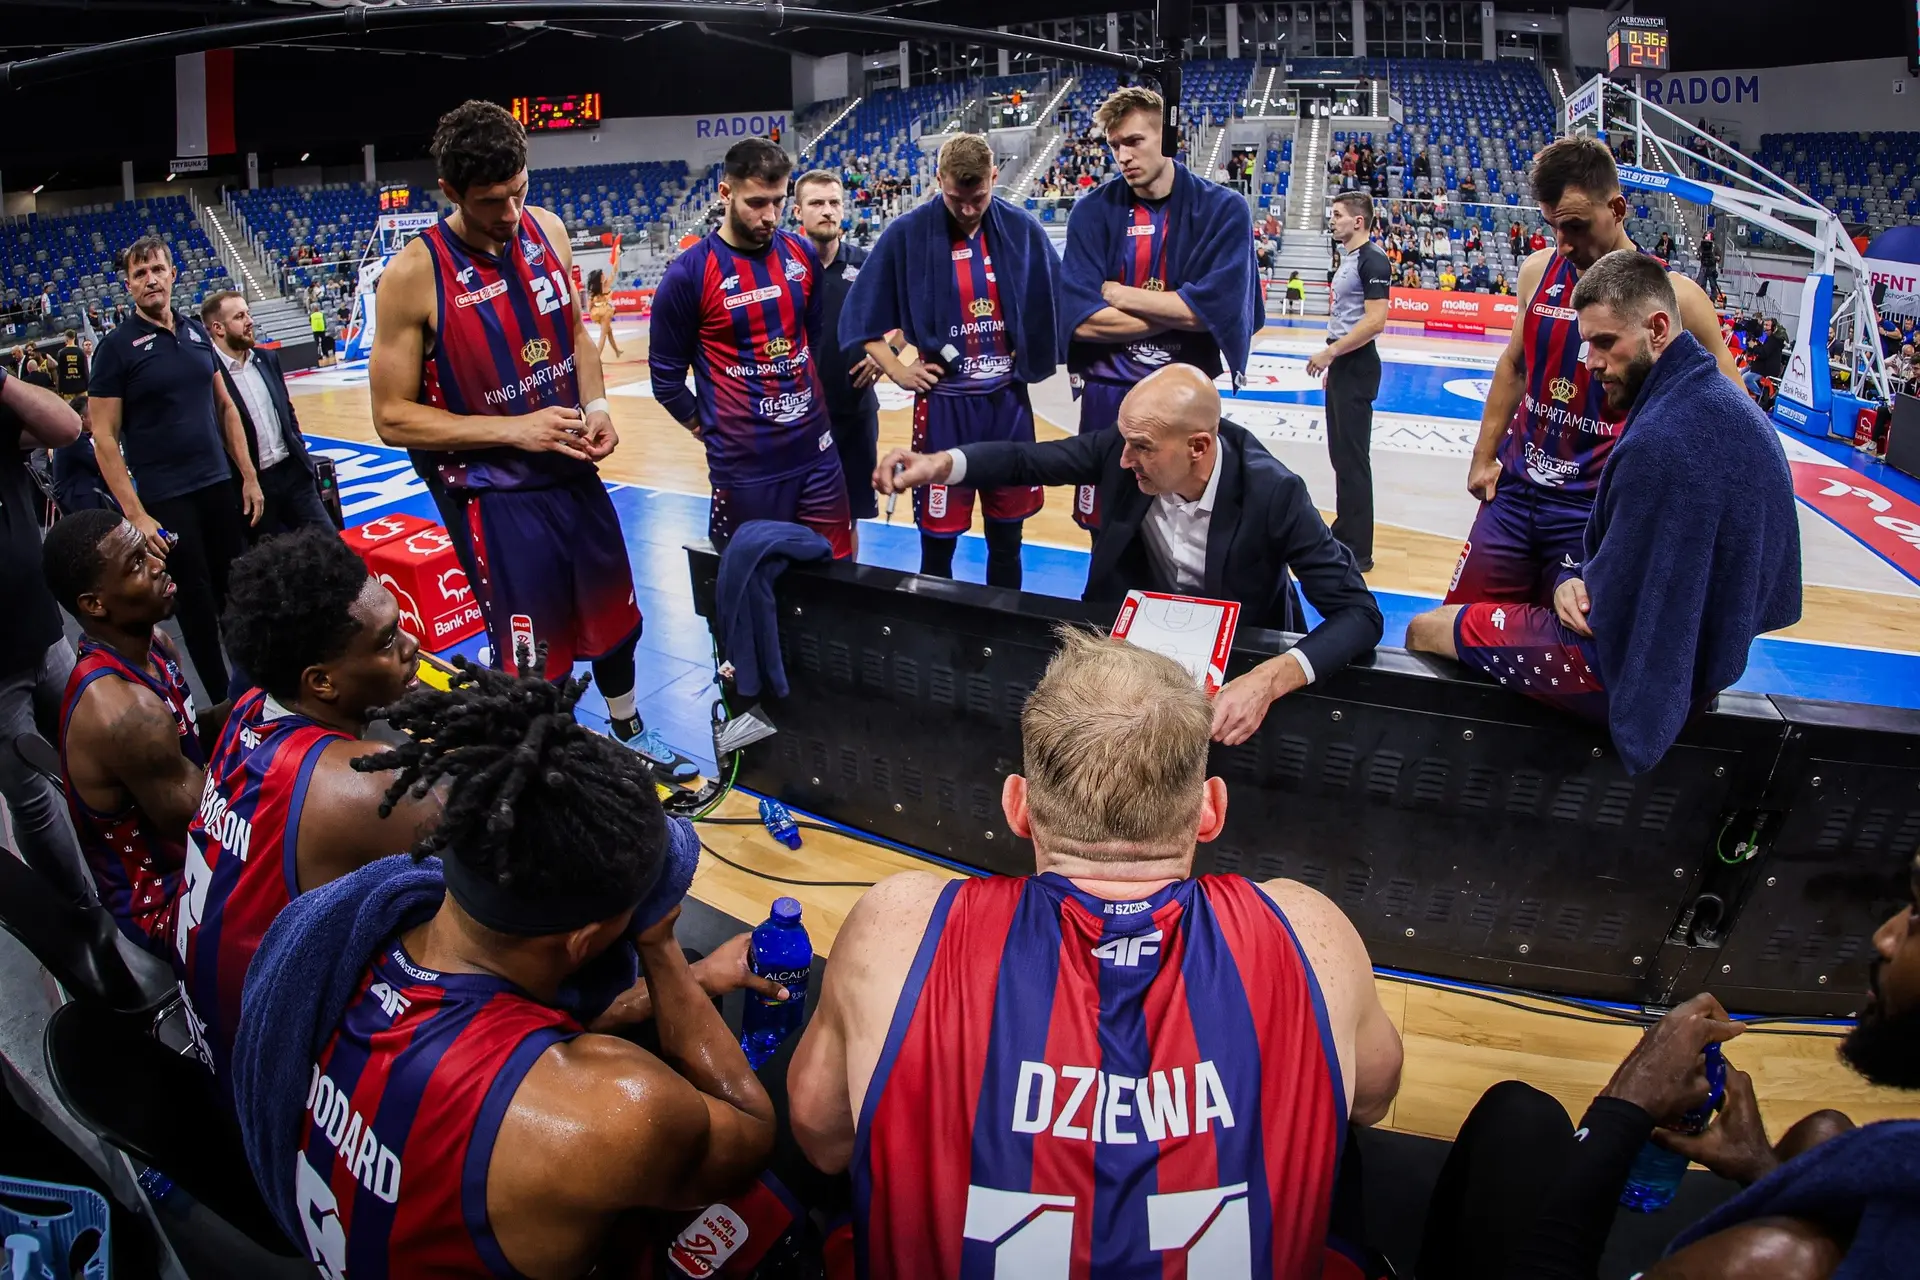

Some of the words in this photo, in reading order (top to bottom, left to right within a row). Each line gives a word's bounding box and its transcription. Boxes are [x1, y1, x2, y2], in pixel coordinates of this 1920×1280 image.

[1620, 16, 1664, 26] AEROWATCH
[1631, 44, 1659, 66] 24
[1645, 75, 1760, 105] RADOM
[1573, 91, 1596, 117] SUZUKI
[696, 115, 786, 138] RADOM
[171, 160, 201, 170] TRYBUNA
[398, 218, 432, 227] SUZUKI
[528, 269, 571, 316] 21
[726, 293, 753, 307] ORLEN
[1394, 297, 1429, 312] Pekao
[1442, 299, 1479, 312] molten
[725, 365, 755, 377] KING
[484, 384, 517, 405] KING
[1794, 386, 1808, 401] Pekao
[1533, 402, 1614, 436] APARTAMENTY
[1554, 462, 1580, 475] 2050
[434, 613, 465, 637] Bank
[1012, 1060, 1236, 1145] DZIEWA
[703, 1216, 735, 1250] Basket
[716, 1215, 737, 1237] Liga
[962, 1181, 1253, 1280] 11
